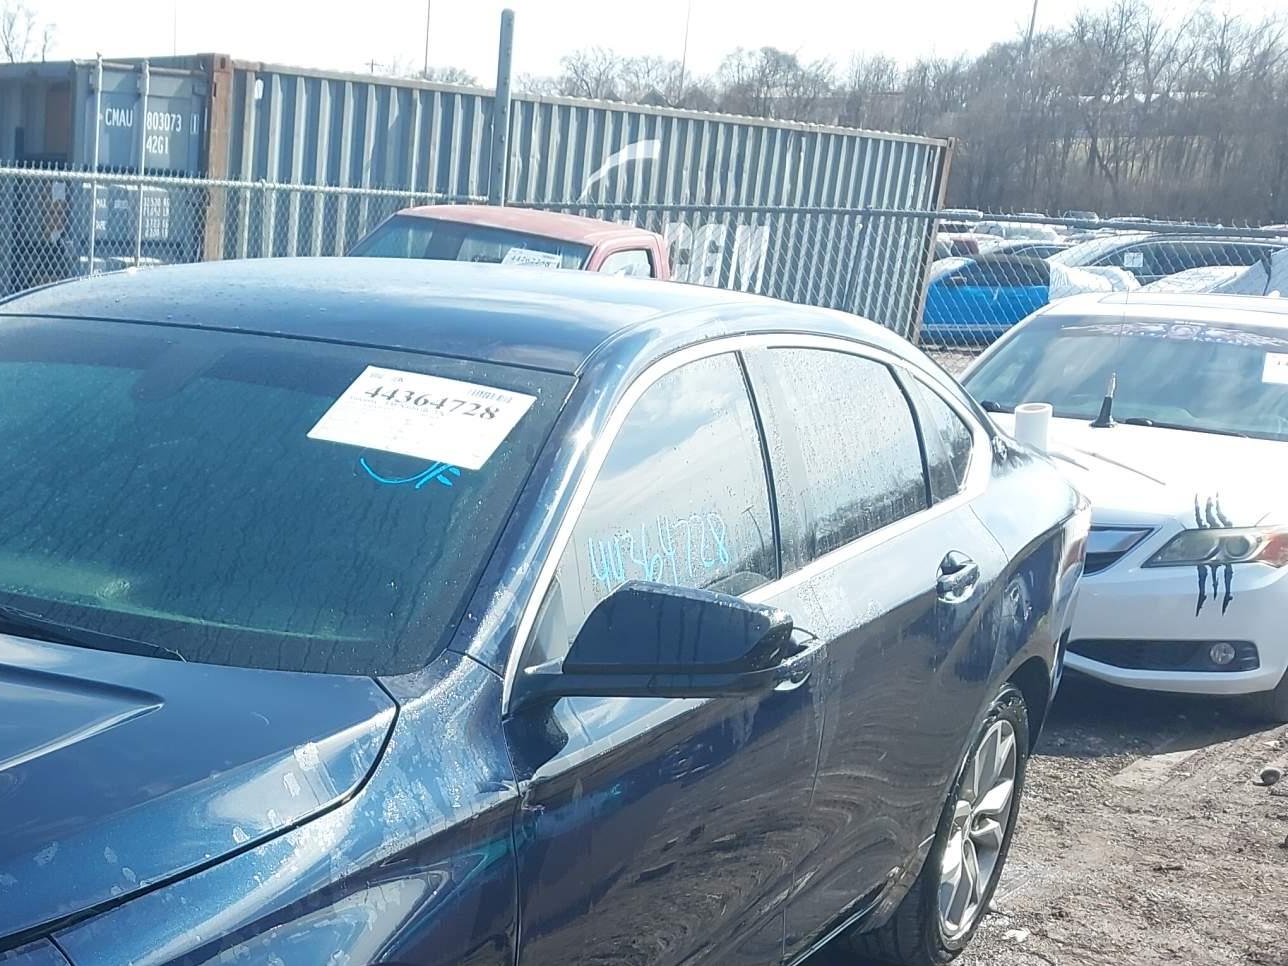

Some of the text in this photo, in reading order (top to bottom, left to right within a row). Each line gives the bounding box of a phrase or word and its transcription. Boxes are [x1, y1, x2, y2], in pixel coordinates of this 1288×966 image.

[105, 108, 133, 127] CMAU
[146, 113, 182, 132] 803073
[146, 135, 169, 154] 42G1
[665, 221, 770, 294] CGM
[364, 385, 500, 420] 44364728
